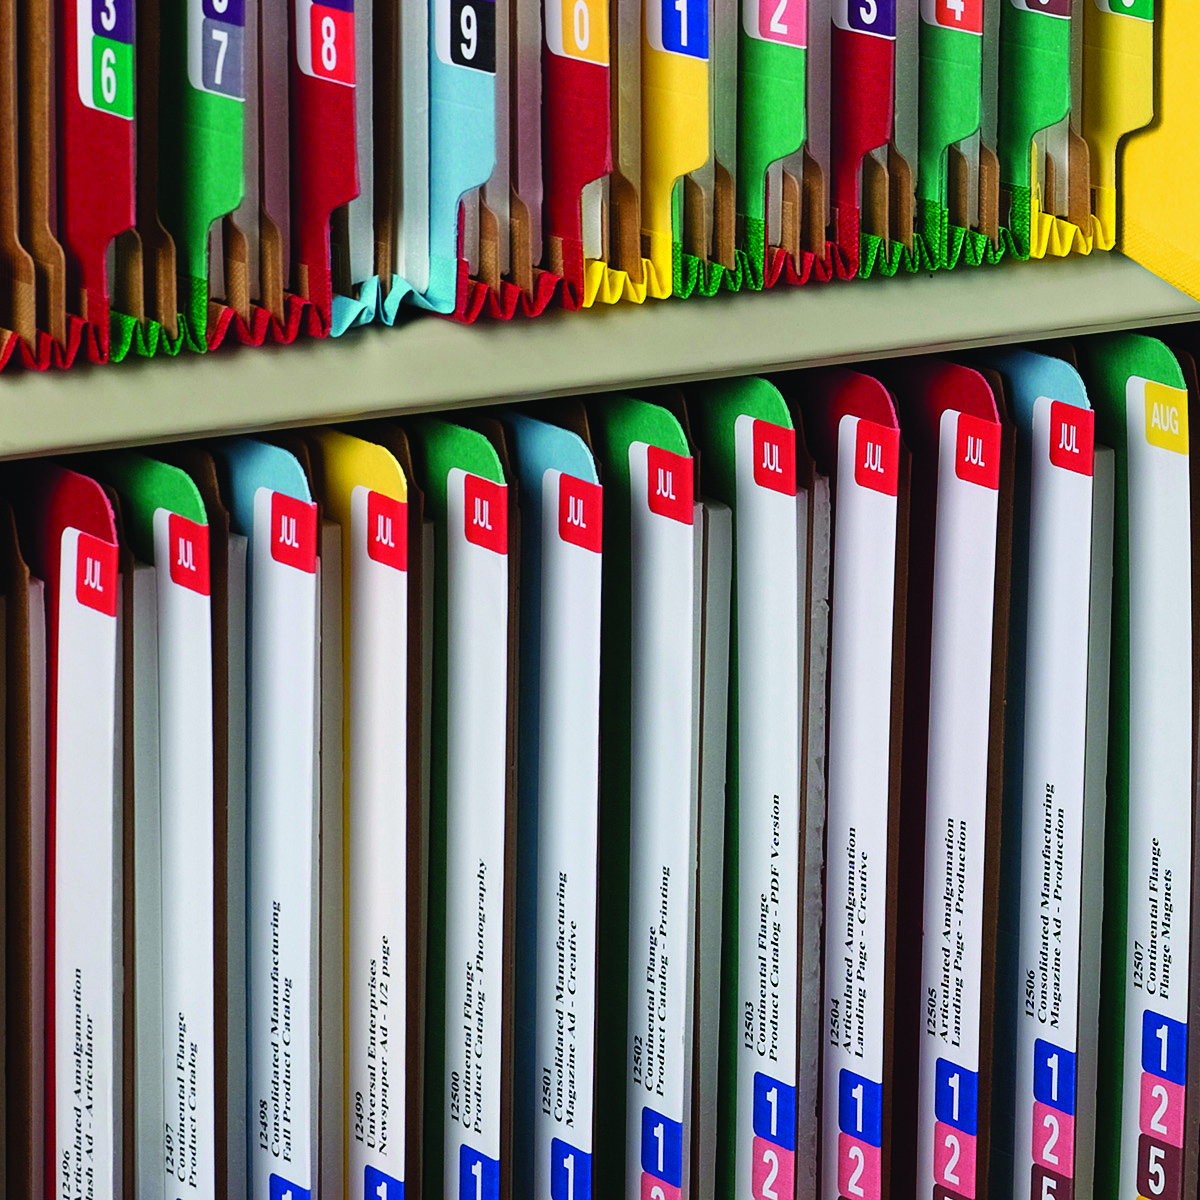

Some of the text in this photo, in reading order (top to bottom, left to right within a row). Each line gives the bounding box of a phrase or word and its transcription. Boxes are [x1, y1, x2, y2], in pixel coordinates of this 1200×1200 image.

[1058, 421, 1080, 455] JUL
[1150, 401, 1180, 435] AUG
[655, 467, 677, 501] JUL
[863, 441, 885, 474] JUL
[278, 514, 300, 549] JUL
[472, 496, 493, 531] JUL
[83, 556, 104, 593] JUL
[1145, 836, 1162, 996] Continental Flange
[1158, 868, 1174, 1001] Flange Magnets
[755, 892, 770, 1058] Continental Flange
[1132, 939, 1145, 991] 12507
[269, 900, 282, 1159] Consolidated Manufacturing
[461, 960, 475, 1130] Continental Flange
[281, 976, 293, 1164] Fall Product Catalog
[175, 1011, 188, 1184] Continental Flange
[187, 1041, 199, 1189] Product Catalog
[162, 1122, 175, 1177] 12497
[258, 1098, 269, 1152] 12498
